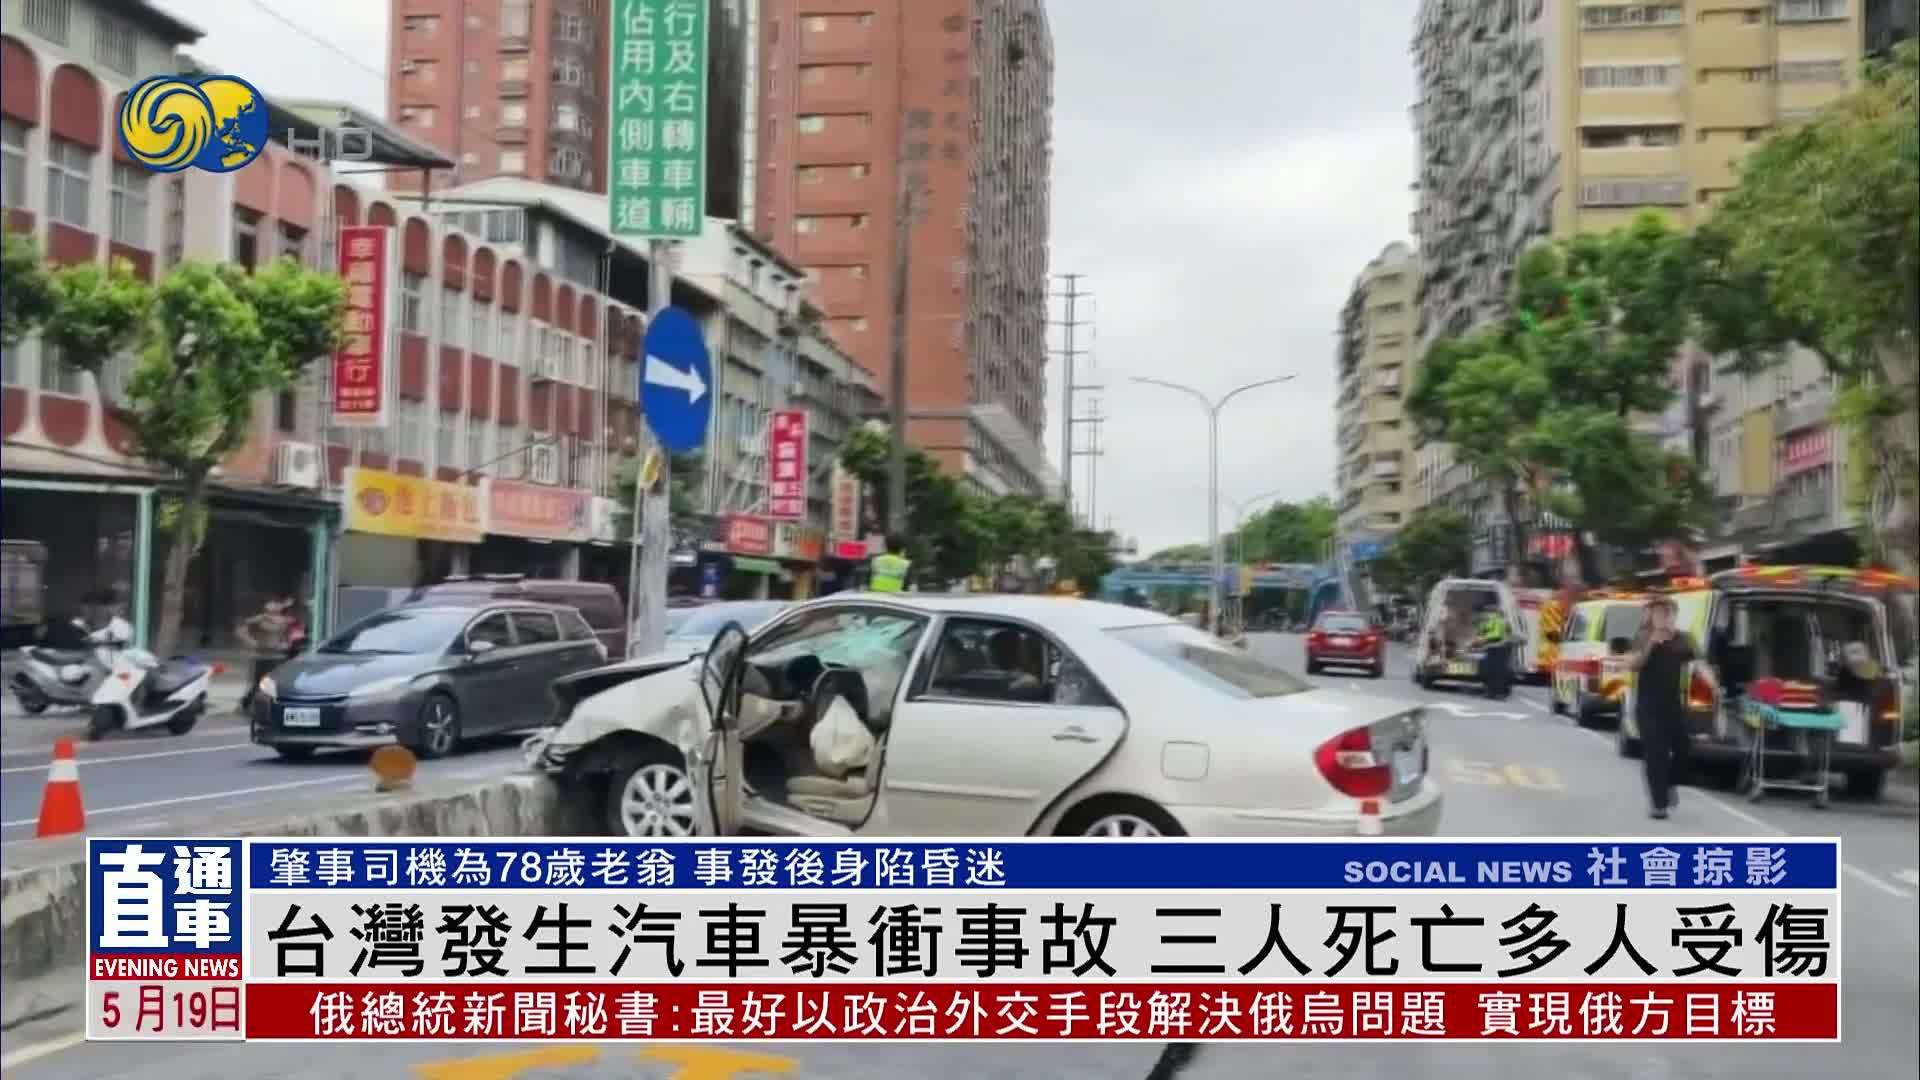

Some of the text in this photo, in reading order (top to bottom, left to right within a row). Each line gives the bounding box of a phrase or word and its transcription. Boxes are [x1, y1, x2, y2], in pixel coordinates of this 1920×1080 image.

[617, 0, 655, 230] 佔用內側車道
[660, 0, 698, 233] 行及右轉車輛
